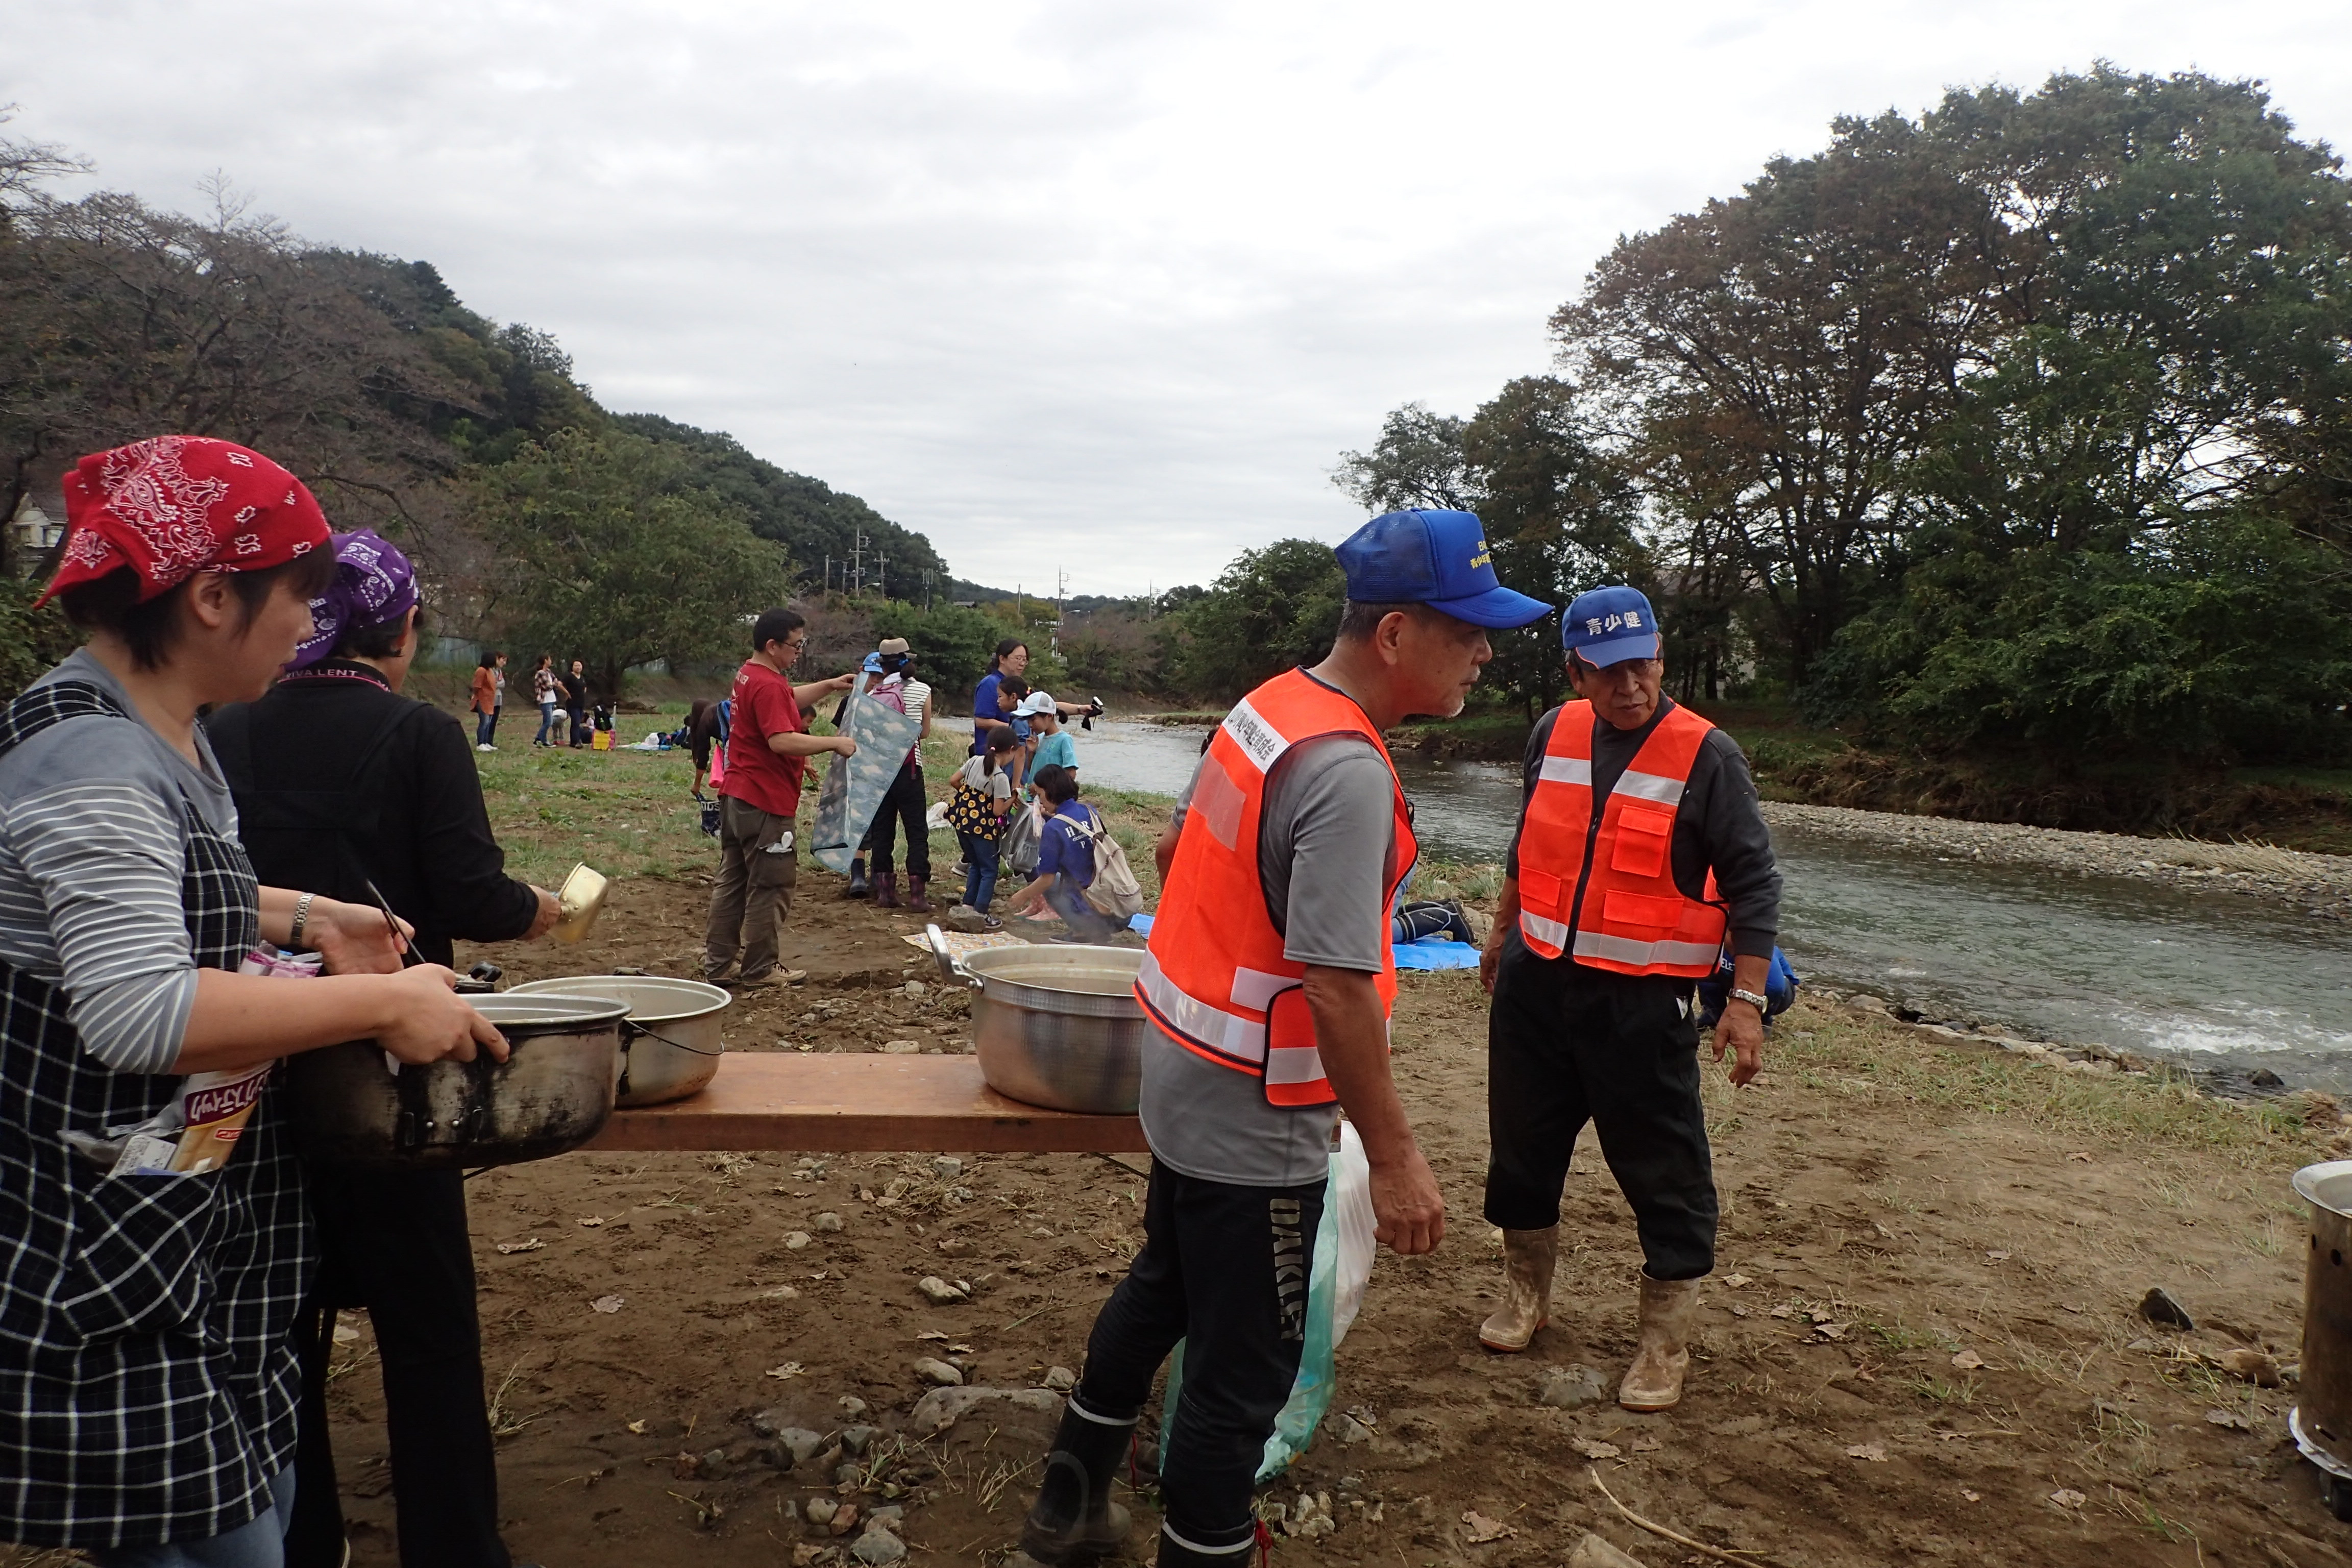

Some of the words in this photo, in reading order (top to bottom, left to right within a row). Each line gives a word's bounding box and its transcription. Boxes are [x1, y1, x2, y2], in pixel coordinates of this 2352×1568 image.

[1586, 610, 1641, 635] 青少健
[1270, 1198, 1304, 1341] OAKLEY
